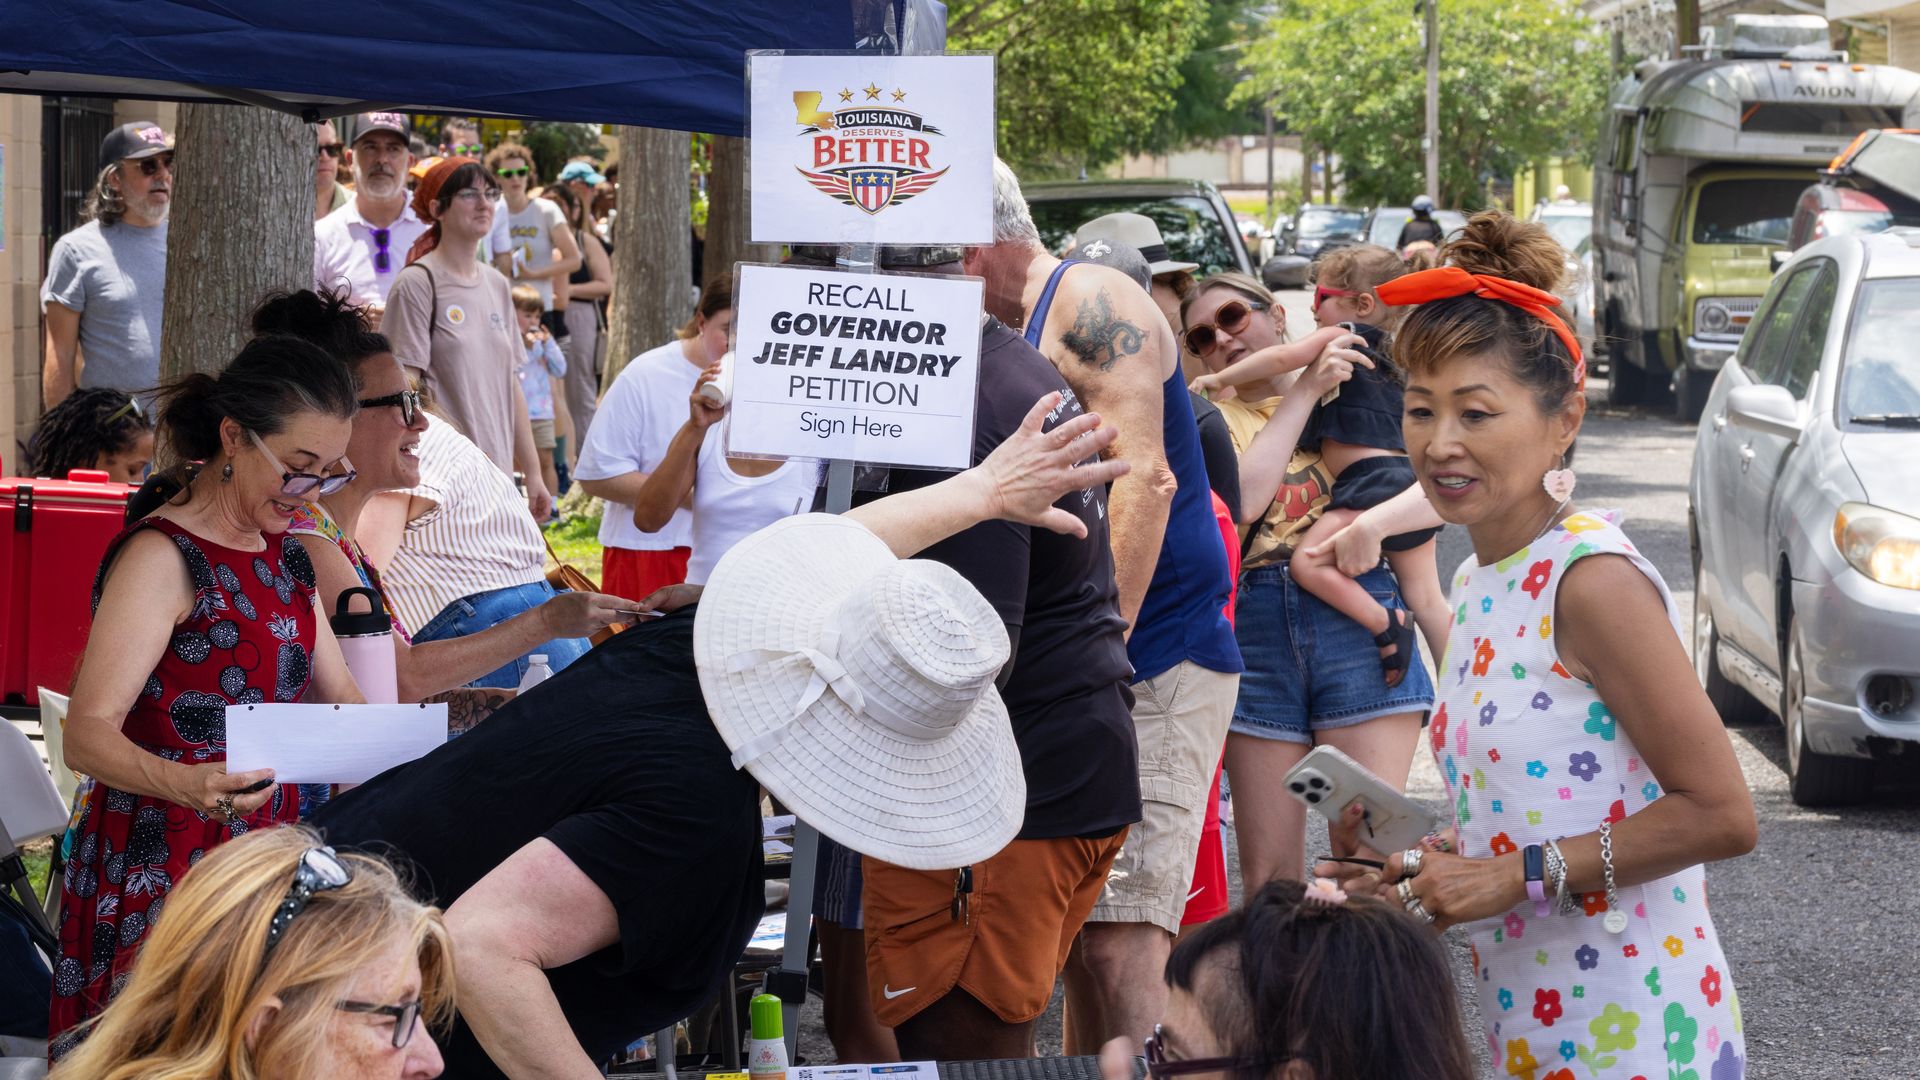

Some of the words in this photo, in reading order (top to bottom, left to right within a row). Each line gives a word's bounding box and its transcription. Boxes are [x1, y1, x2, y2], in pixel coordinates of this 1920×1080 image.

[1793, 85, 1856, 98] AVION
[838, 112, 913, 128] LOUISIANA
[842, 127, 904, 138] DESERVES
[813, 135, 932, 169] BETTER
[808, 282, 914, 312] RECALL
[770, 311, 947, 346] GOVERNOR
[752, 342, 824, 368] JEFF
[830, 347, 962, 378] LANDRY
[789, 375, 919, 407] PETITION
[800, 411, 845, 439] Sign
[852, 415, 903, 438] Here
